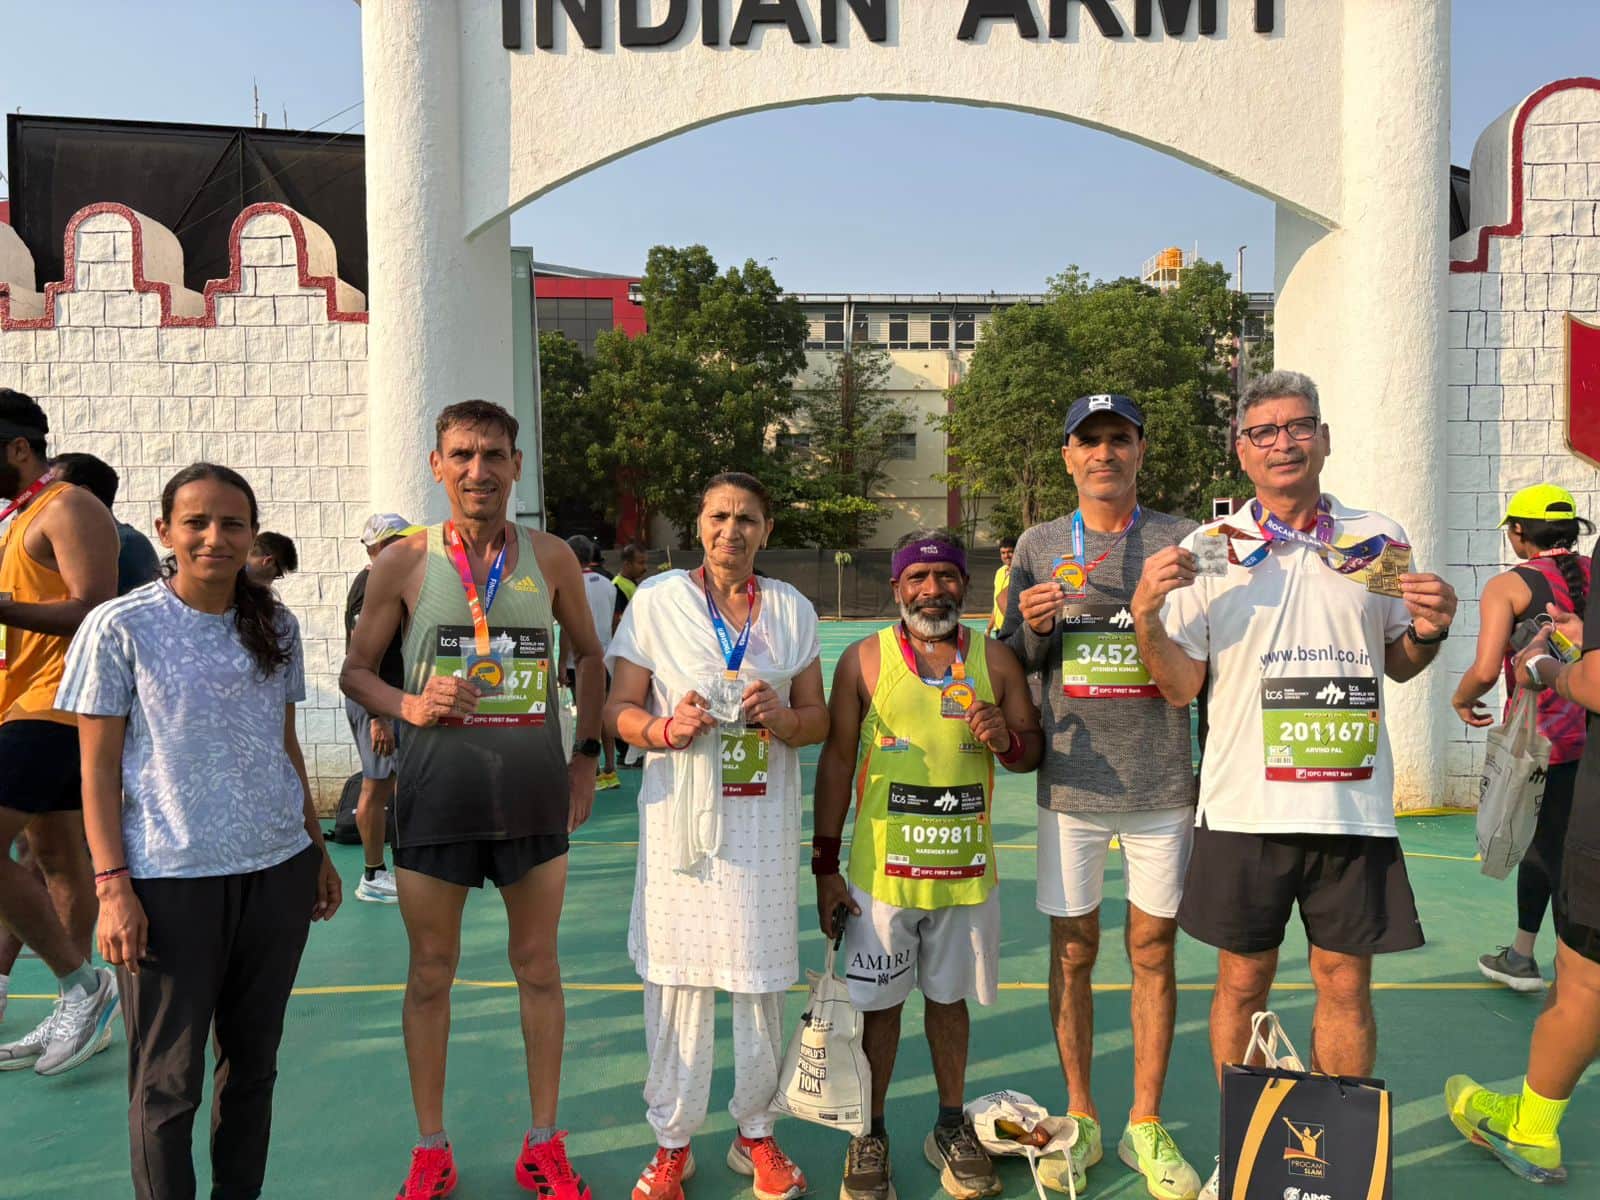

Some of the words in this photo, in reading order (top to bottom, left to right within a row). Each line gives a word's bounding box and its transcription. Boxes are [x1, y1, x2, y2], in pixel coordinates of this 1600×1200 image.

[440, 636, 458, 647] tcs
[1076, 644, 1143, 665] 3452
[1265, 688, 1283, 700] tcs
[1279, 722, 1365, 742] 201167
[891, 793, 906, 805] tcs
[901, 824, 971, 844] 109981
[851, 949, 910, 970] AMIRI
[800, 1073, 820, 1093] 10K
[1304, 1167, 1323, 1176] SLAM
